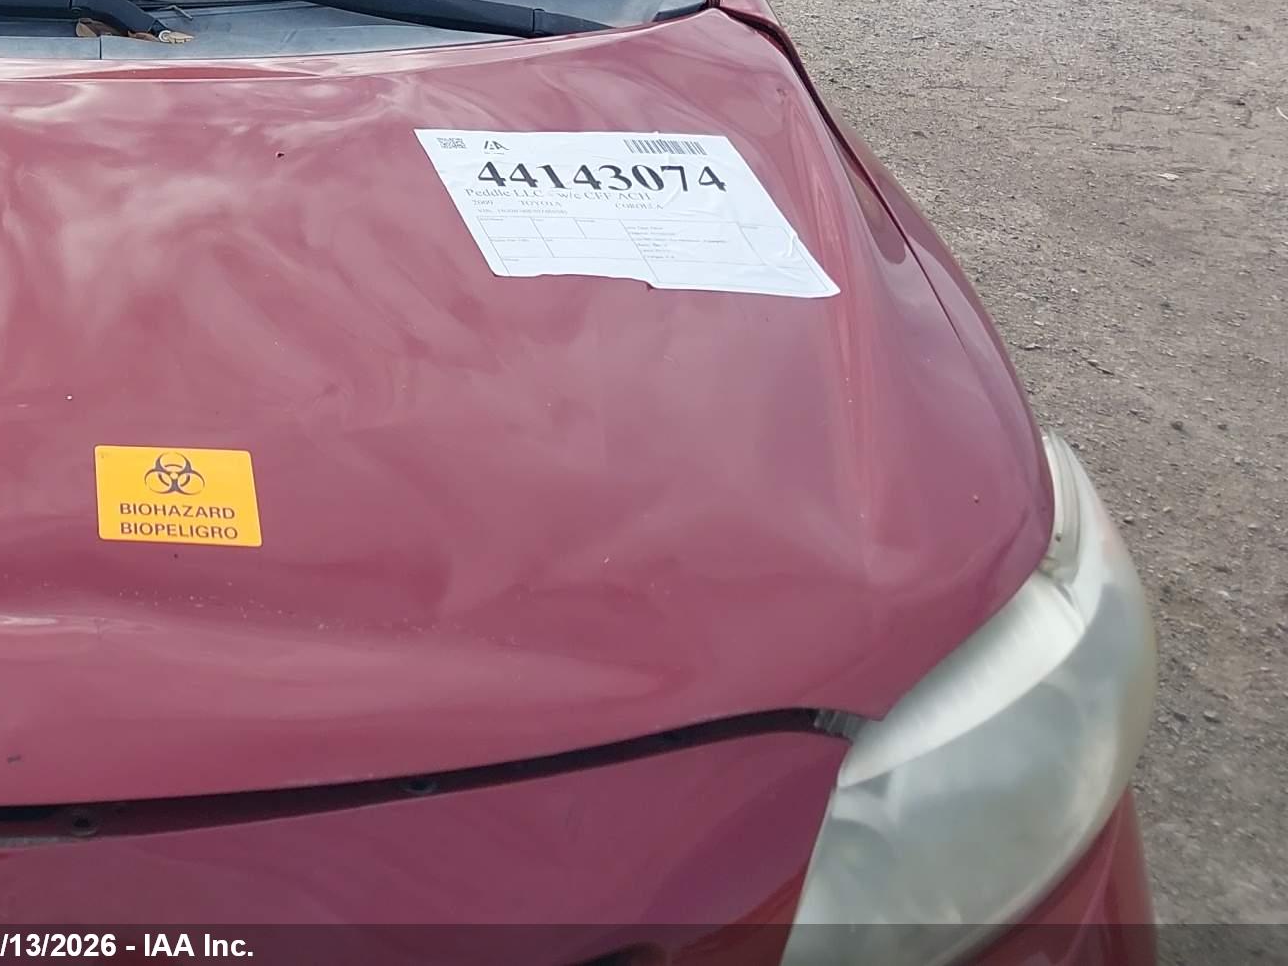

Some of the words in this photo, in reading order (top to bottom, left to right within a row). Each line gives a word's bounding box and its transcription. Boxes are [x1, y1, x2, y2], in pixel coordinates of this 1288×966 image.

[478, 161, 728, 192] 44143074
[465, 188, 511, 197] Peddle
[513, 189, 544, 198] LLC
[120, 503, 235, 520] BIOHAZARD
[120, 522, 239, 540] BIOPELIGRO
